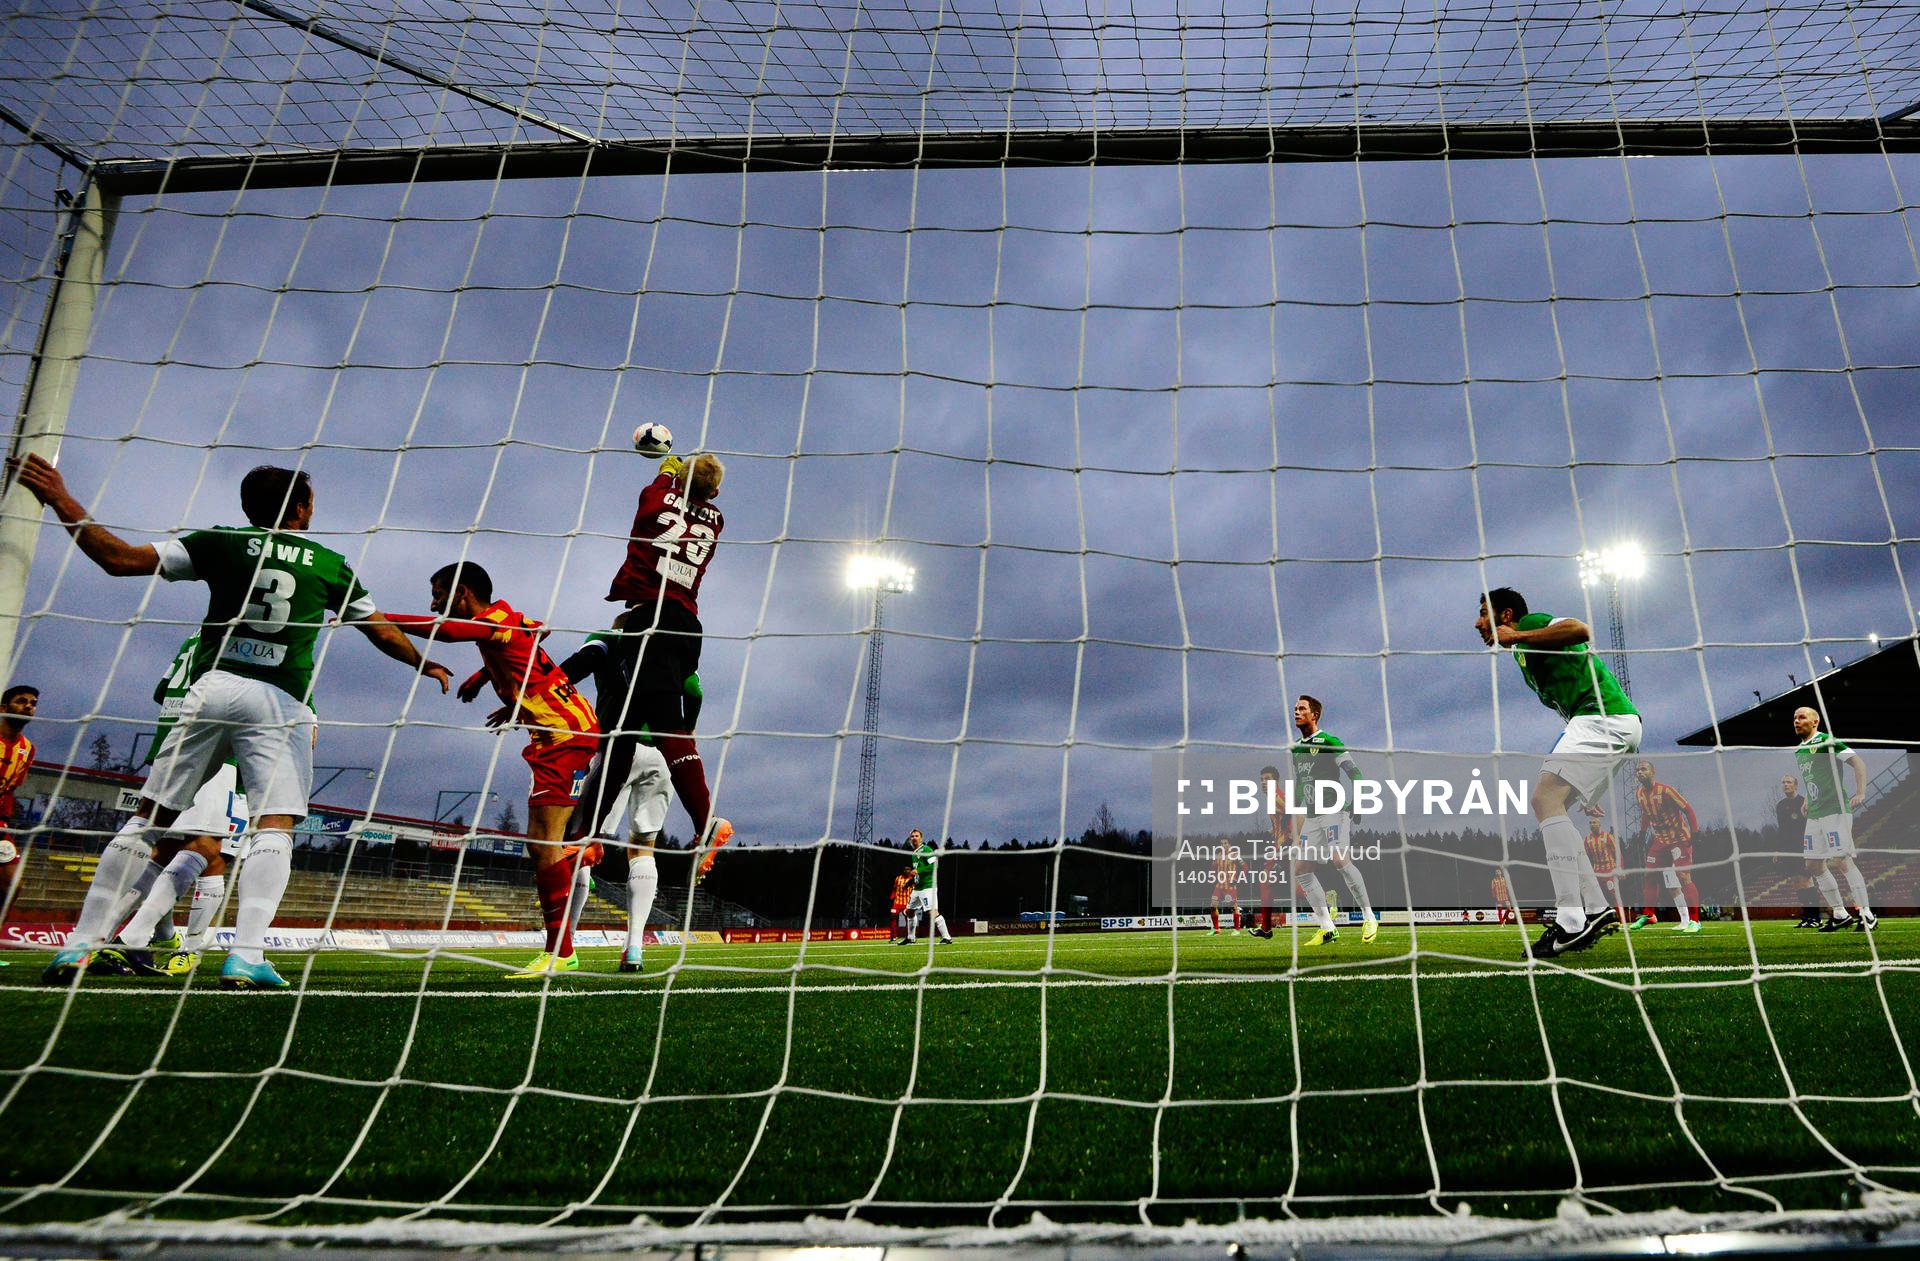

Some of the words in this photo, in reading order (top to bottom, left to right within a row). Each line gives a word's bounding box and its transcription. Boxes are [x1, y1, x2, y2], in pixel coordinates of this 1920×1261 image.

[246, 538, 314, 567] SIWE
[652, 511, 715, 565] 23
[243, 568, 297, 634] 3
[228, 641, 275, 659] AQUA
